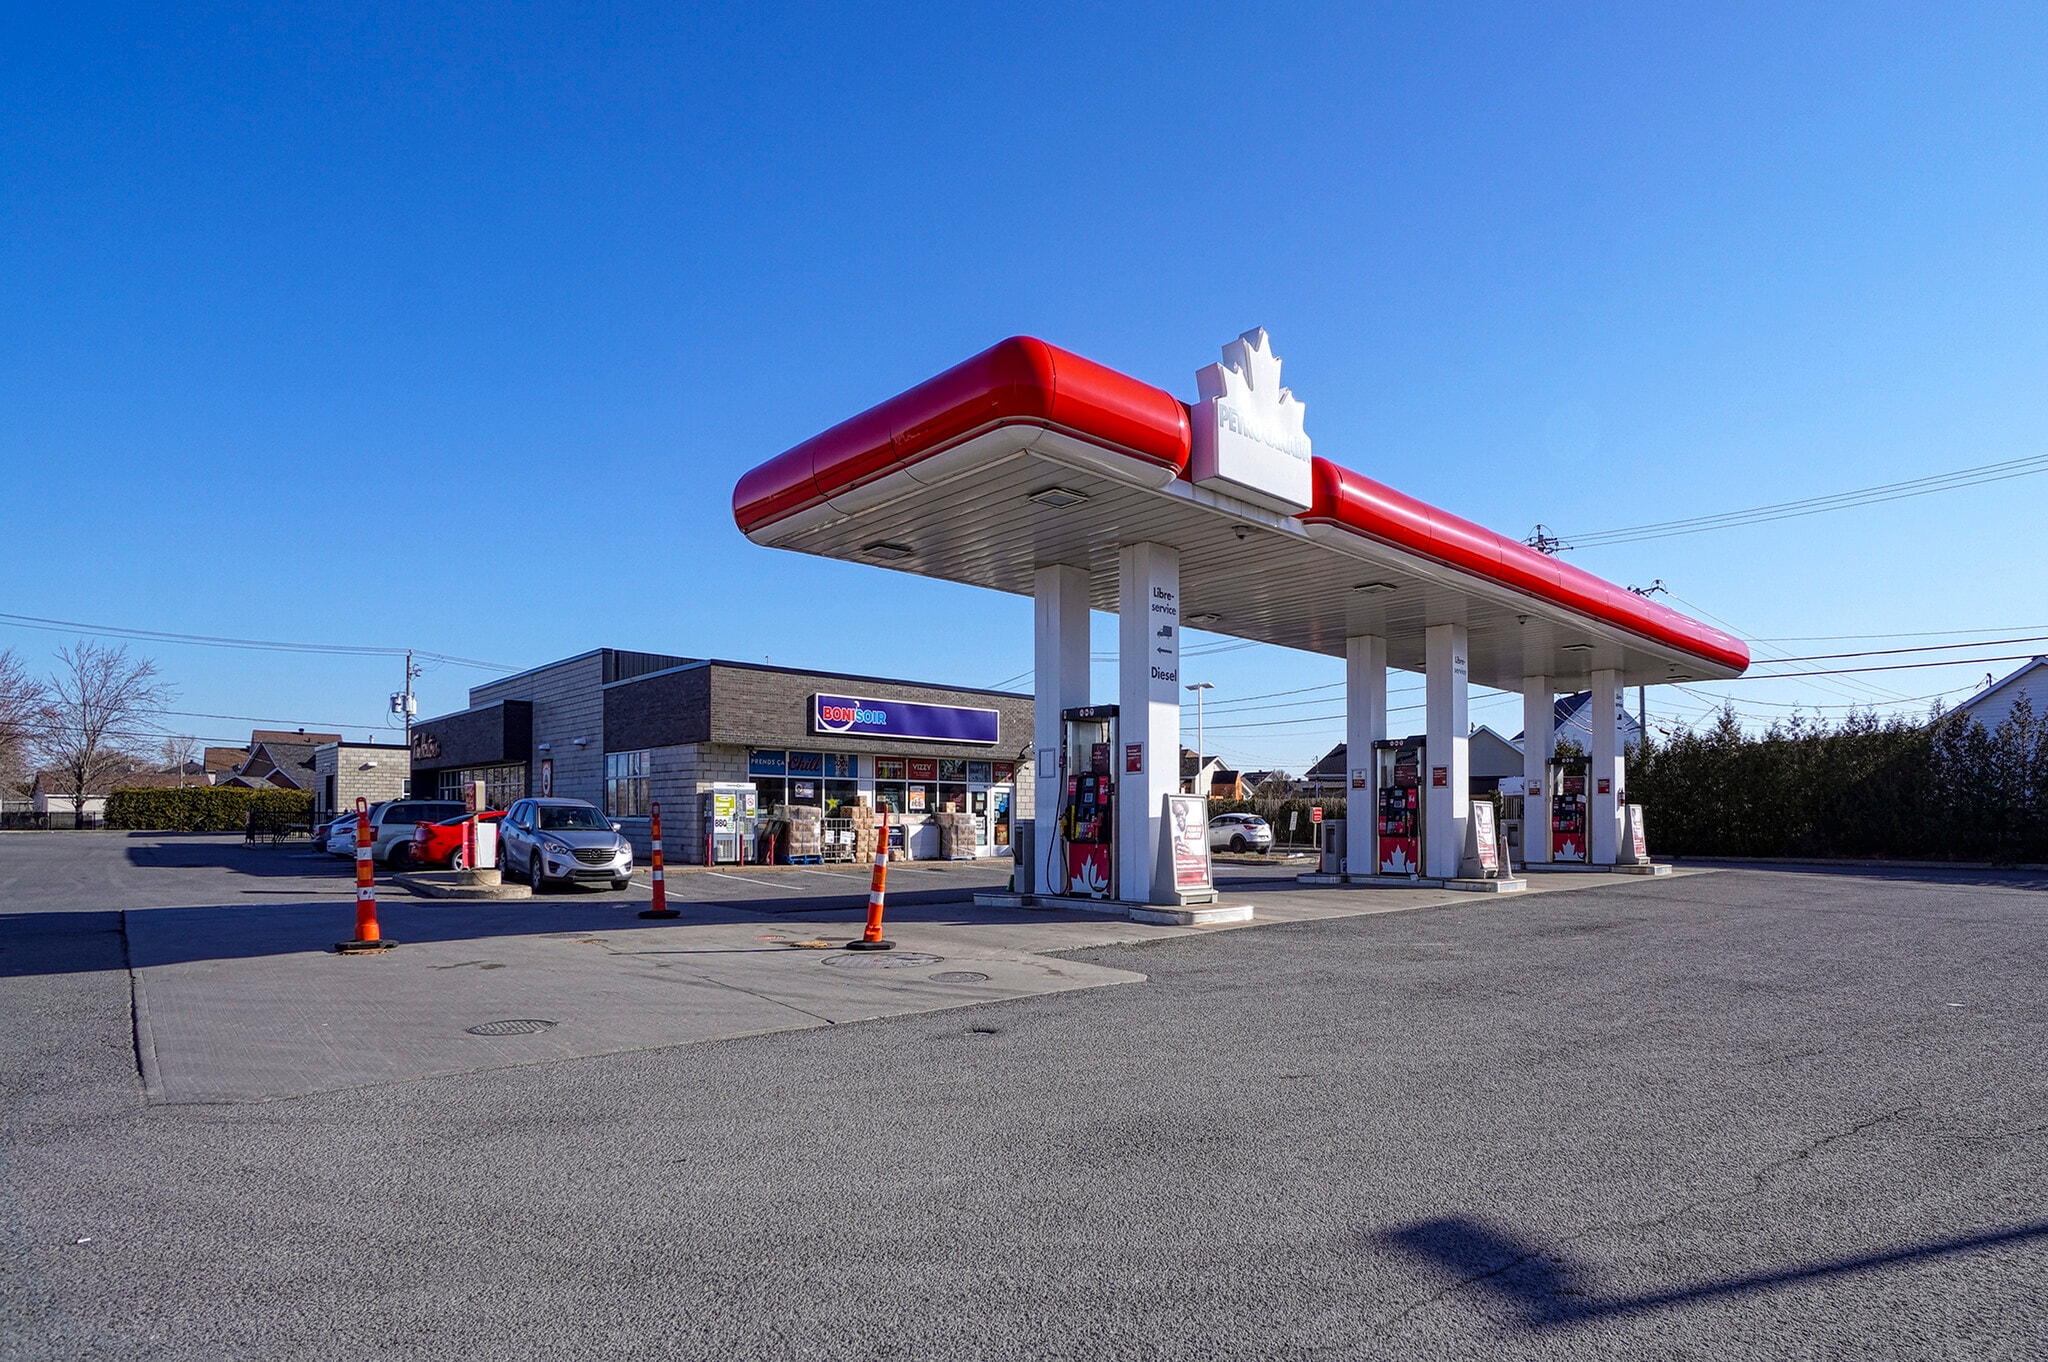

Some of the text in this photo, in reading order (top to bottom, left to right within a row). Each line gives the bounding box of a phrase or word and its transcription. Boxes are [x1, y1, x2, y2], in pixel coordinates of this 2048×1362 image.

[1153, 587, 1175, 601] Libre-
[1151, 603, 1177, 616] service
[1151, 666, 1178, 682] Diesel
[751, 758, 776, 766] PRENDS
[788, 756, 822, 772] Chill
[912, 763, 932, 771] VIZZY
